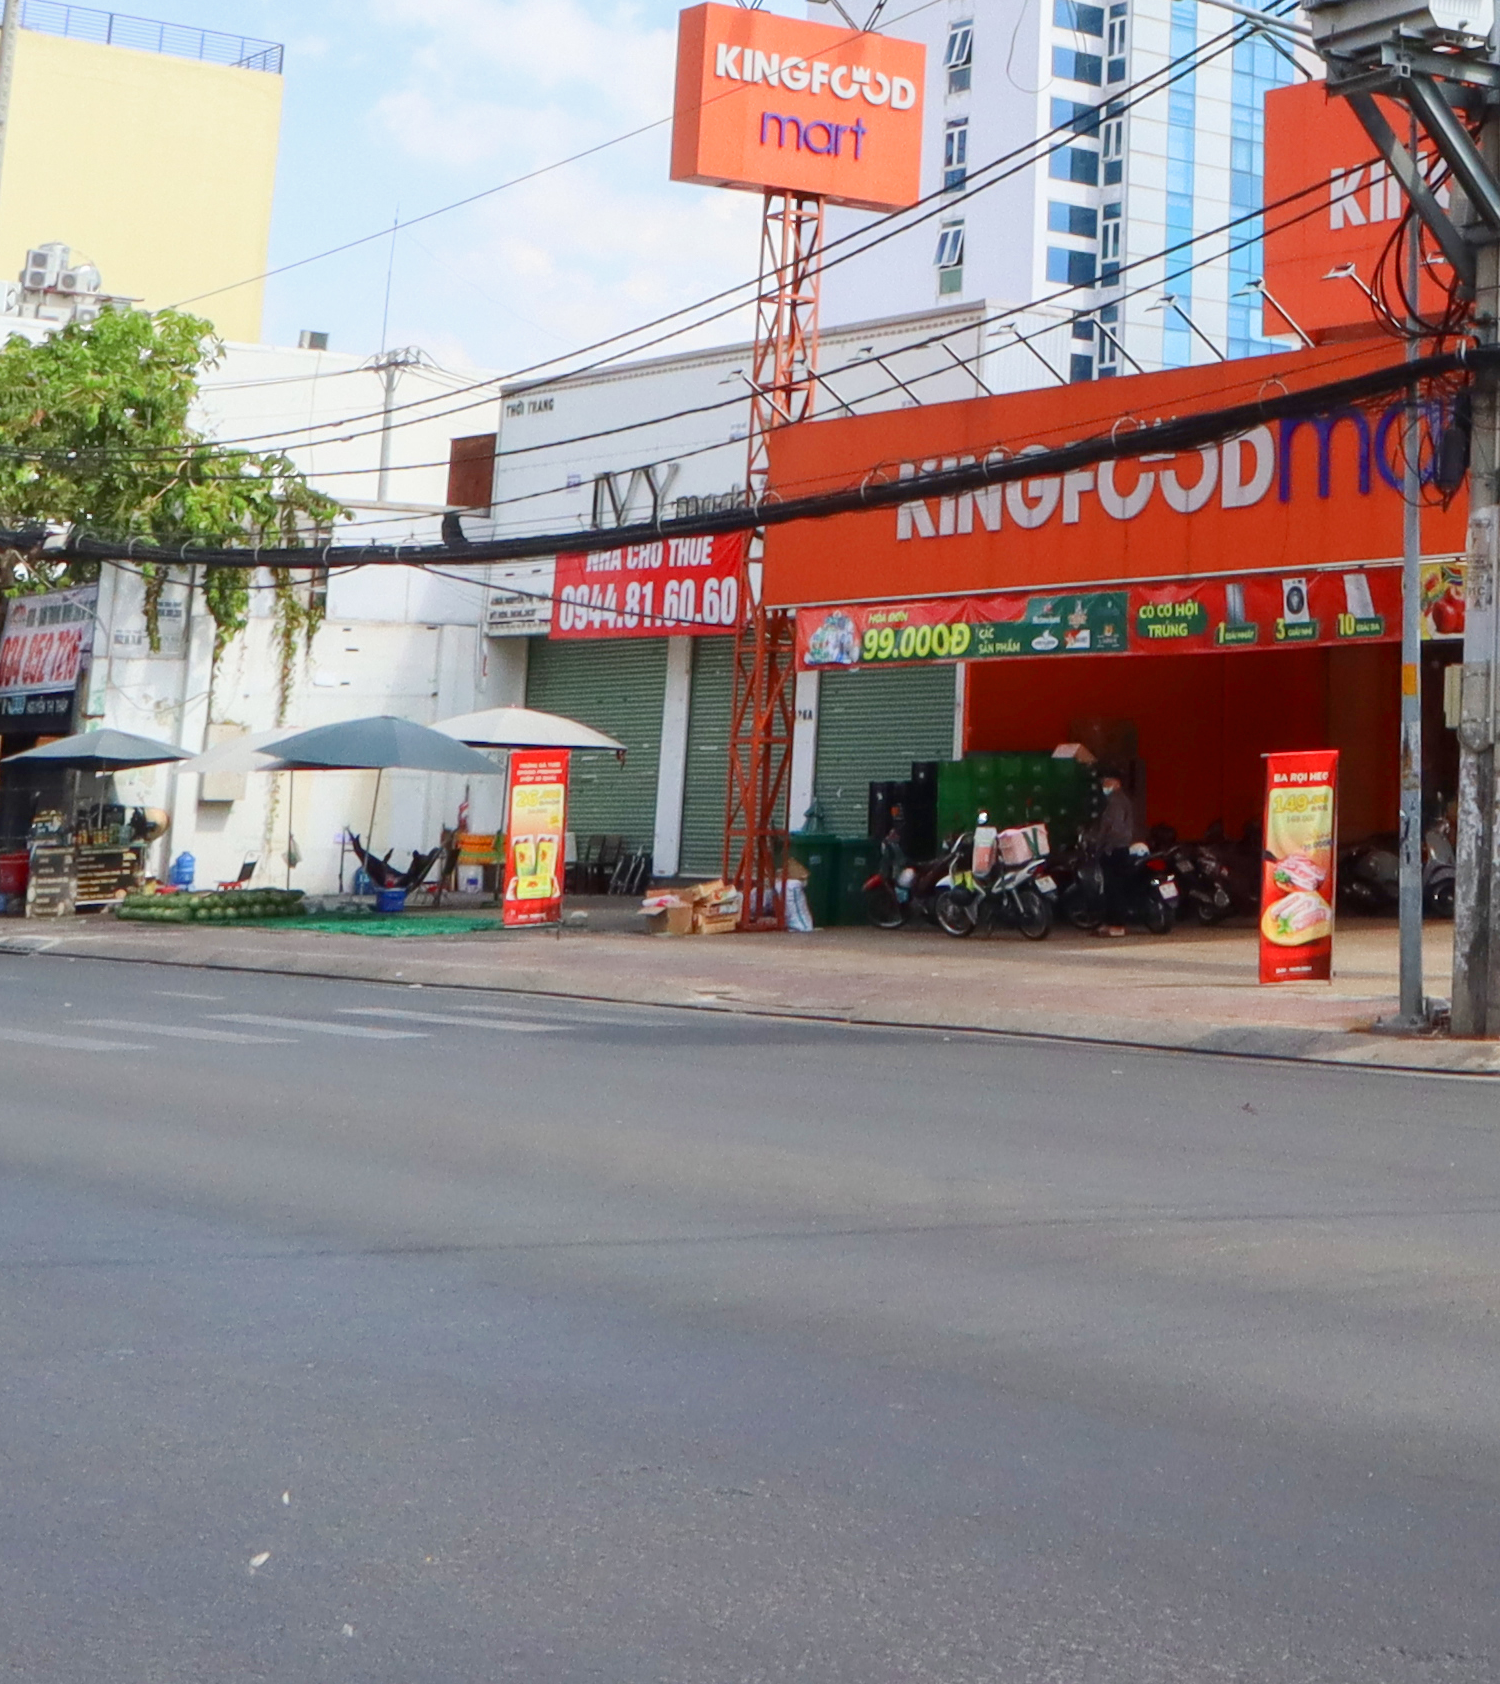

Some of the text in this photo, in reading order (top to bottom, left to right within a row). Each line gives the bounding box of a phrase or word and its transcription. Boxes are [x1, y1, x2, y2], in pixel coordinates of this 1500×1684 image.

[714, 42, 917, 112] KINGFOOD
[760, 111, 868, 161] mart
[591, 463, 681, 529] IVY
[626, 541, 664, 569] CHO
[559, 576, 739, 631] 0944.81.60.60
[1138, 598, 1199, 620] CÓ CƠ HỘI
[979, 626, 994, 640] CÁC
[1148, 620, 1189, 639] TRÚNG
[1218, 622, 1226, 644] 1
[1276, 618, 1285, 640] 3
[1338, 612, 1356, 636] 10
[862, 622, 971, 661] 99.000Đ
[978, 637, 1021, 654] SẢN PHẨM
